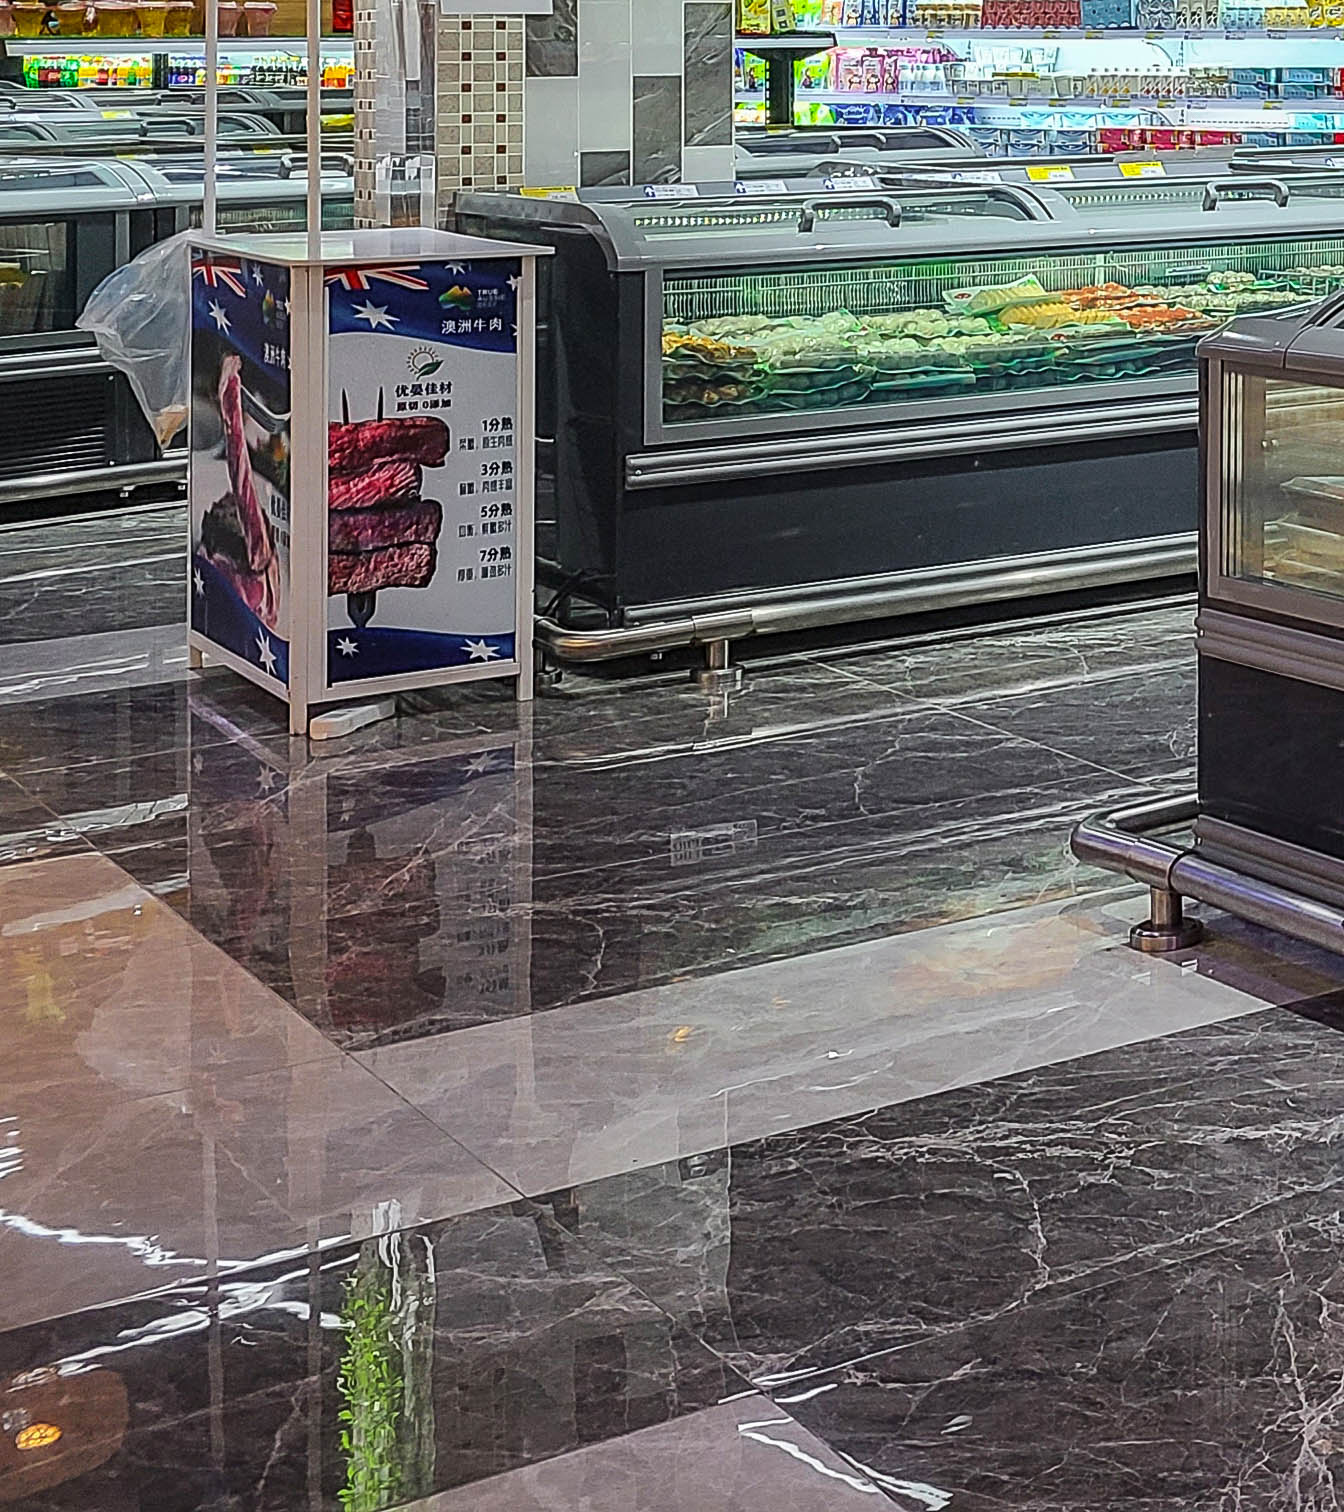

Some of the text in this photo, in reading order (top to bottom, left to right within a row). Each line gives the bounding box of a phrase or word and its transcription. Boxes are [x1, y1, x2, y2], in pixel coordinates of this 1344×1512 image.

[477, 288, 499, 296] TRUE
[441, 316, 503, 335] 澳洲牛肉
[482, 416, 514, 433] 1分熟
[480, 460, 514, 477] 3分熟
[480, 502, 513, 518] 5分熟
[479, 545, 512, 562] 7分熟
